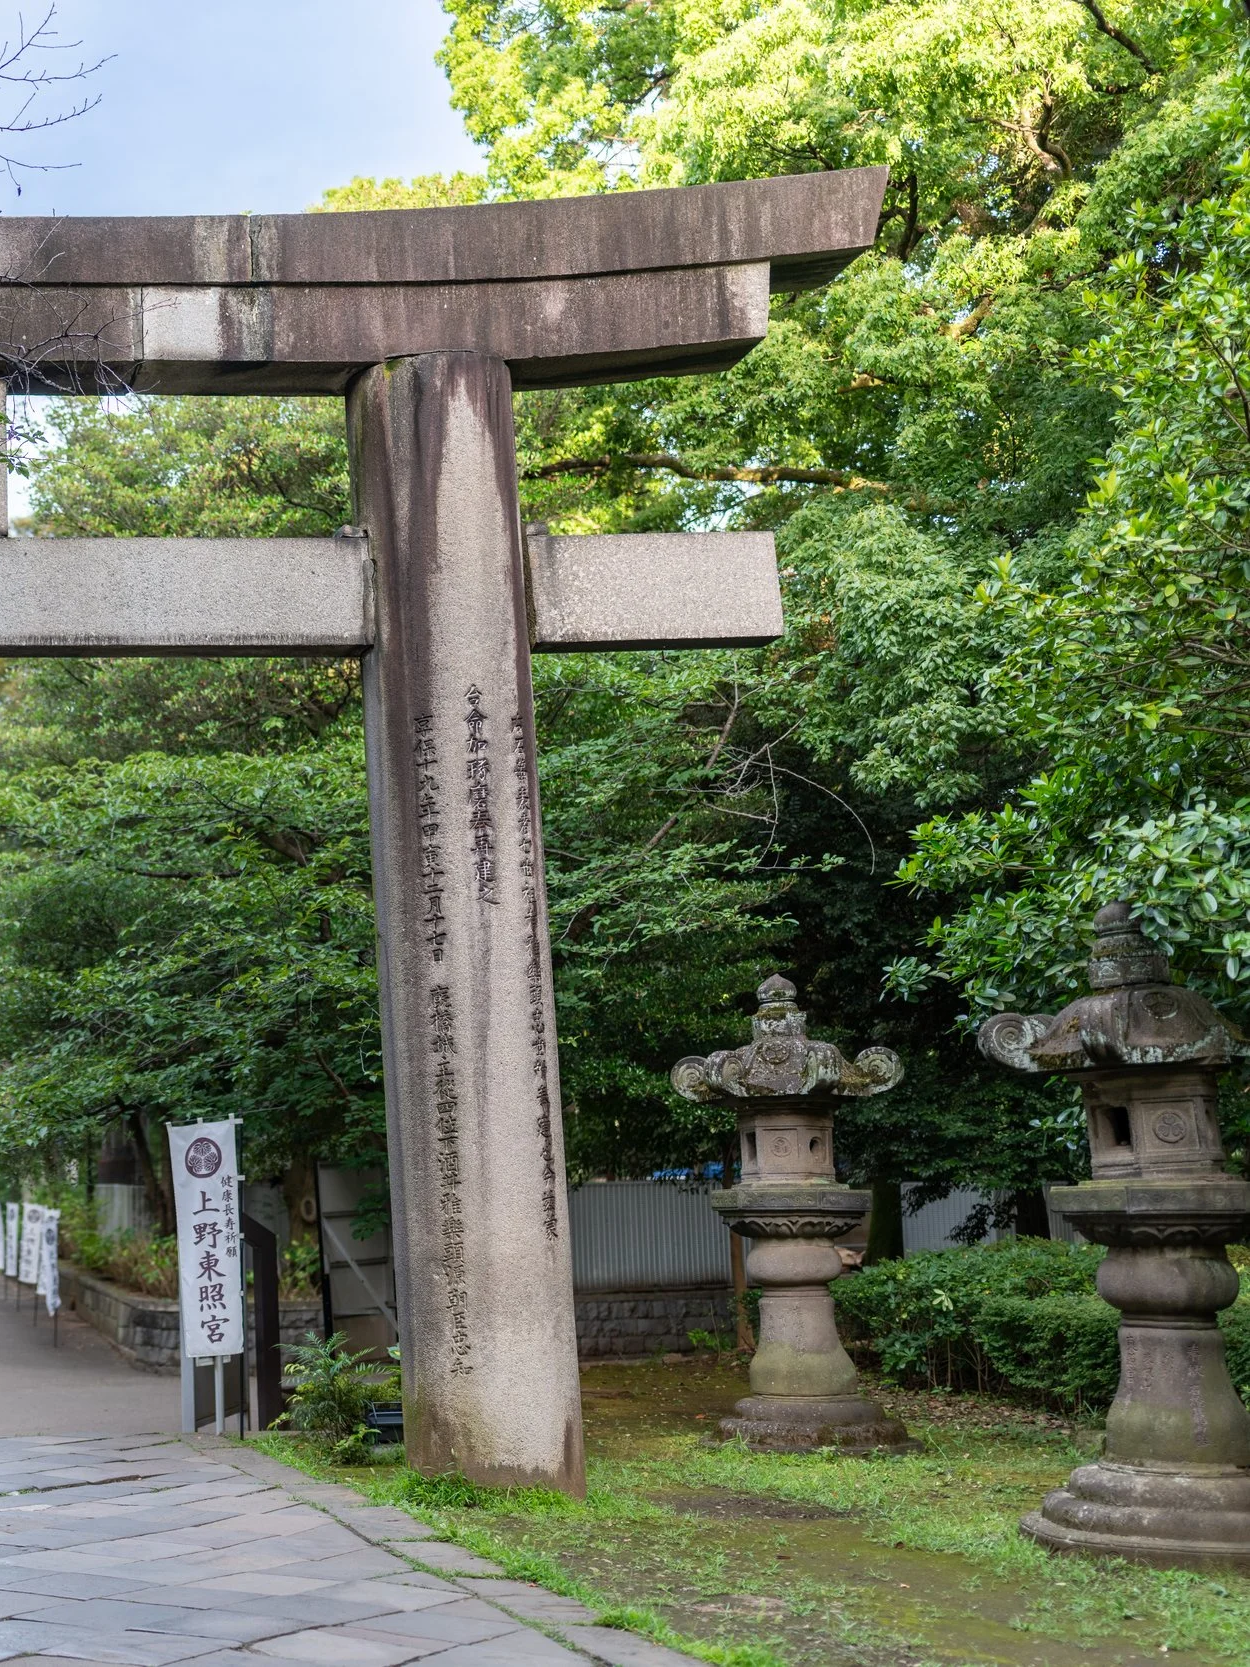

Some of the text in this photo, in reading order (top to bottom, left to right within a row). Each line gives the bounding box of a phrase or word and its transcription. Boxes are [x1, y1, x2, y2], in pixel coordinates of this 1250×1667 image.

[414, 713, 448, 963] 享保十九年甲寅十二月十七日
[192, 1190, 230, 1345] 上野東照宮
[220, 1175, 238, 1258] 健康長寿祈願
